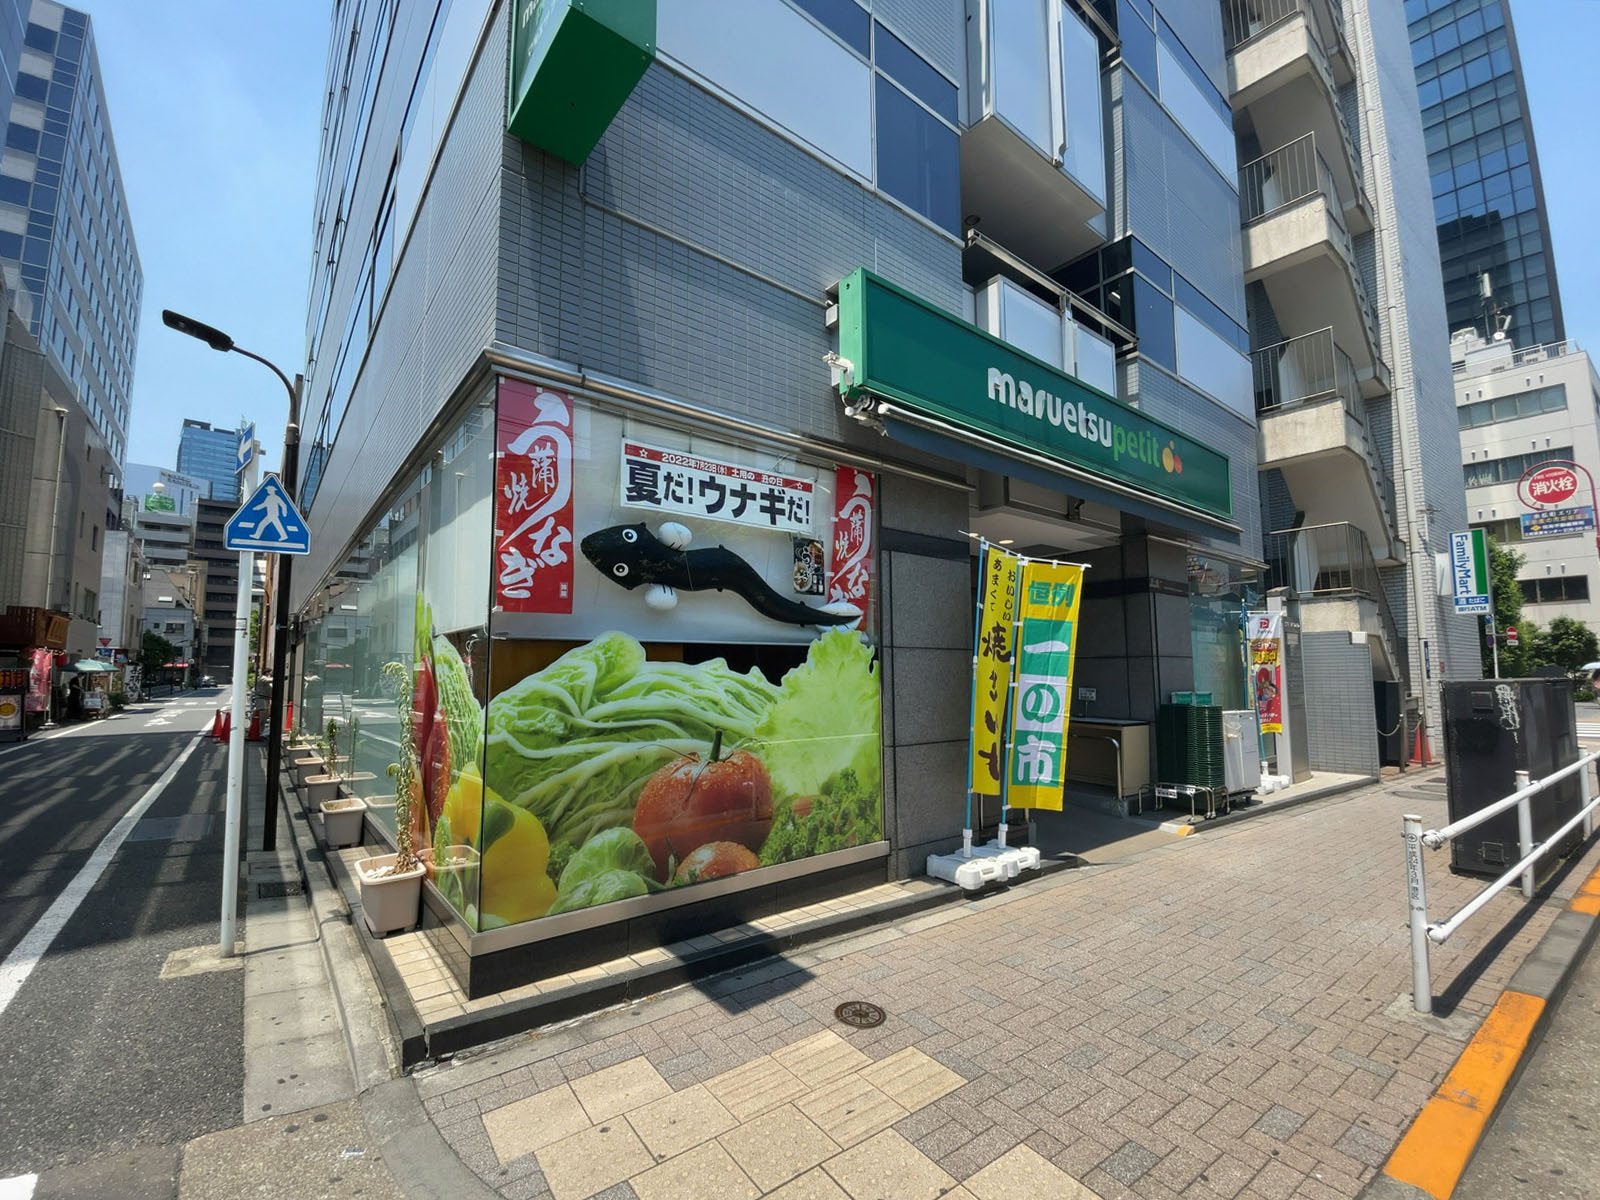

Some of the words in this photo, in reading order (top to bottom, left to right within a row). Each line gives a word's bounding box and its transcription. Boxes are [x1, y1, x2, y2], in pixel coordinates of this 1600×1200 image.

[987, 366, 1113, 448] maruetsu
[1113, 423, 1161, 469] petit
[499, 392, 573, 599] うなぎ
[504, 442, 557, 516] 蒲焼
[1531, 475, 1575, 497] 消火栓
[989, 557, 1003, 612] あまくて
[1027, 580, 1076, 608] 恒例
[1454, 533, 1472, 595] FamilyMart
[1002, 569, 1016, 622] おいしい
[1017, 639, 1070, 785] 一の市
